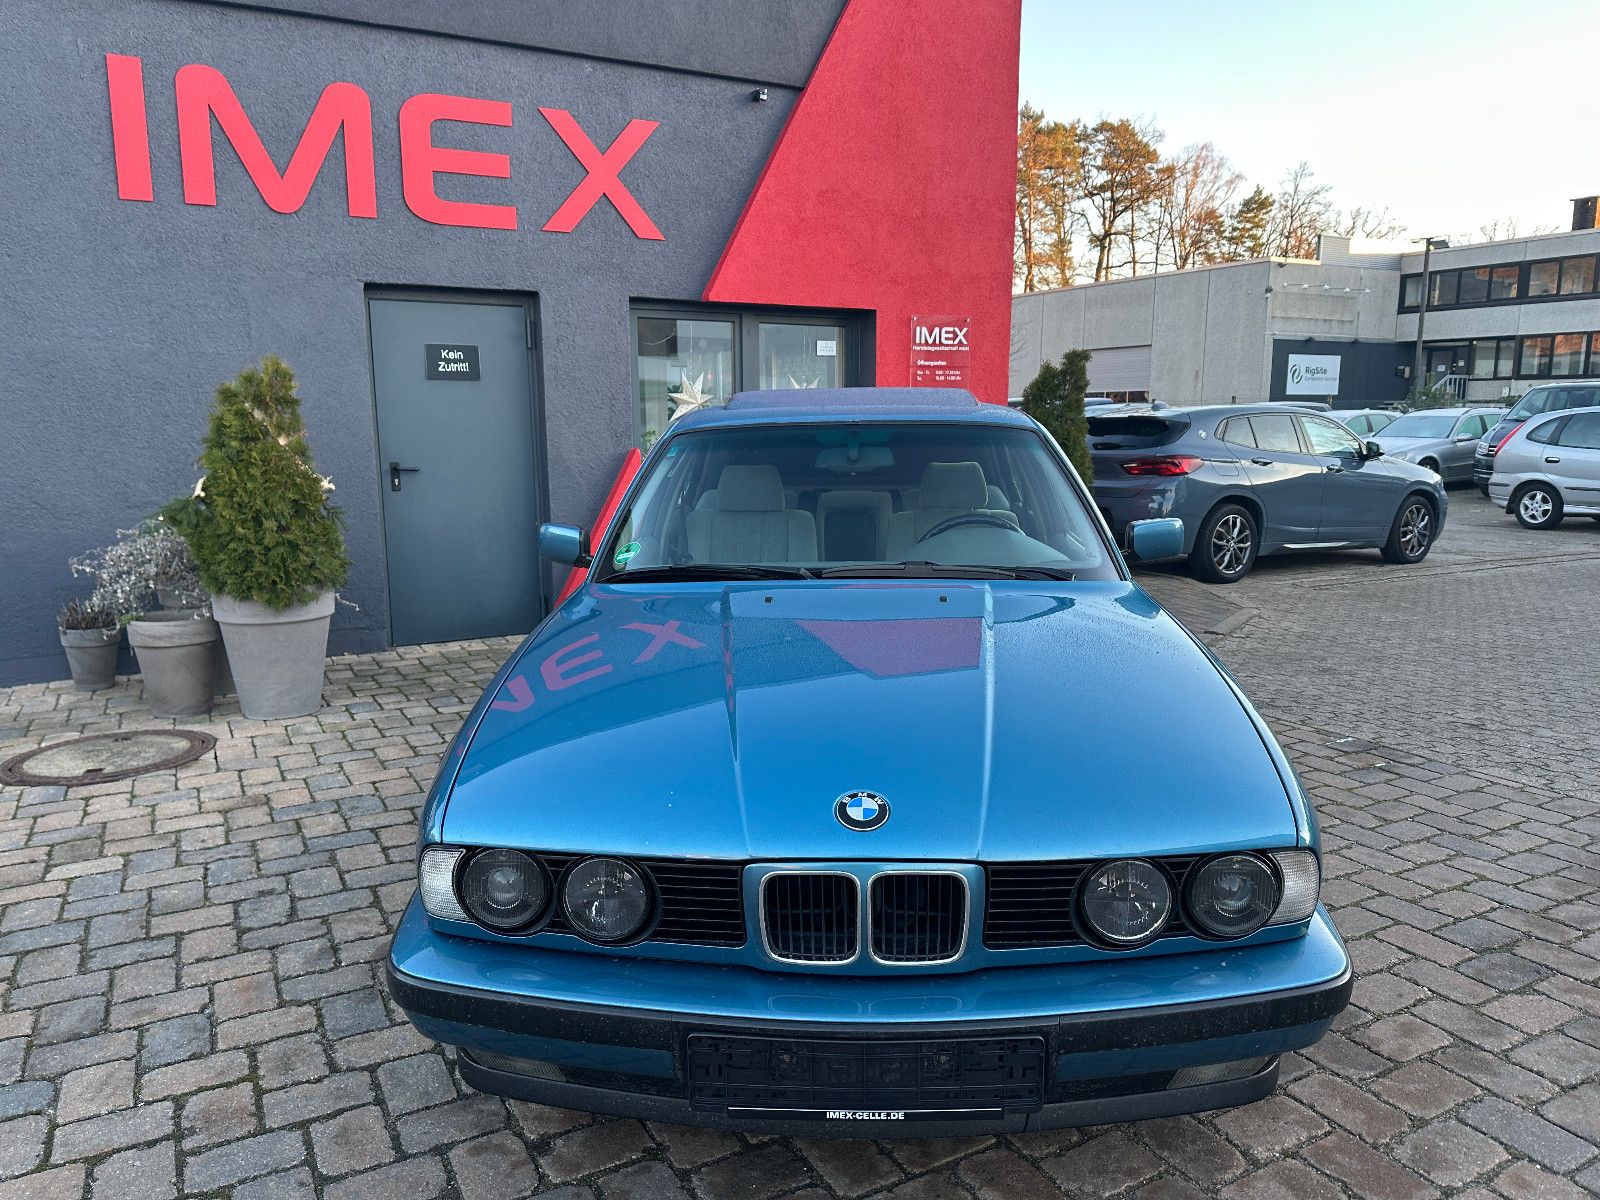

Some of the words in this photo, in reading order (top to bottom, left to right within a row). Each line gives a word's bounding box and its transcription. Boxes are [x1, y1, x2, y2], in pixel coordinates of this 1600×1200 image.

[106, 53, 666, 241] IMEX
[915, 326, 968, 344] IMEX
[440, 350, 464, 360] Kein
[438, 361, 469, 372] Zutritt!
[842, 792, 885, 805] BMW
[826, 1111, 905, 1120] IMEX-CELLE.DE
